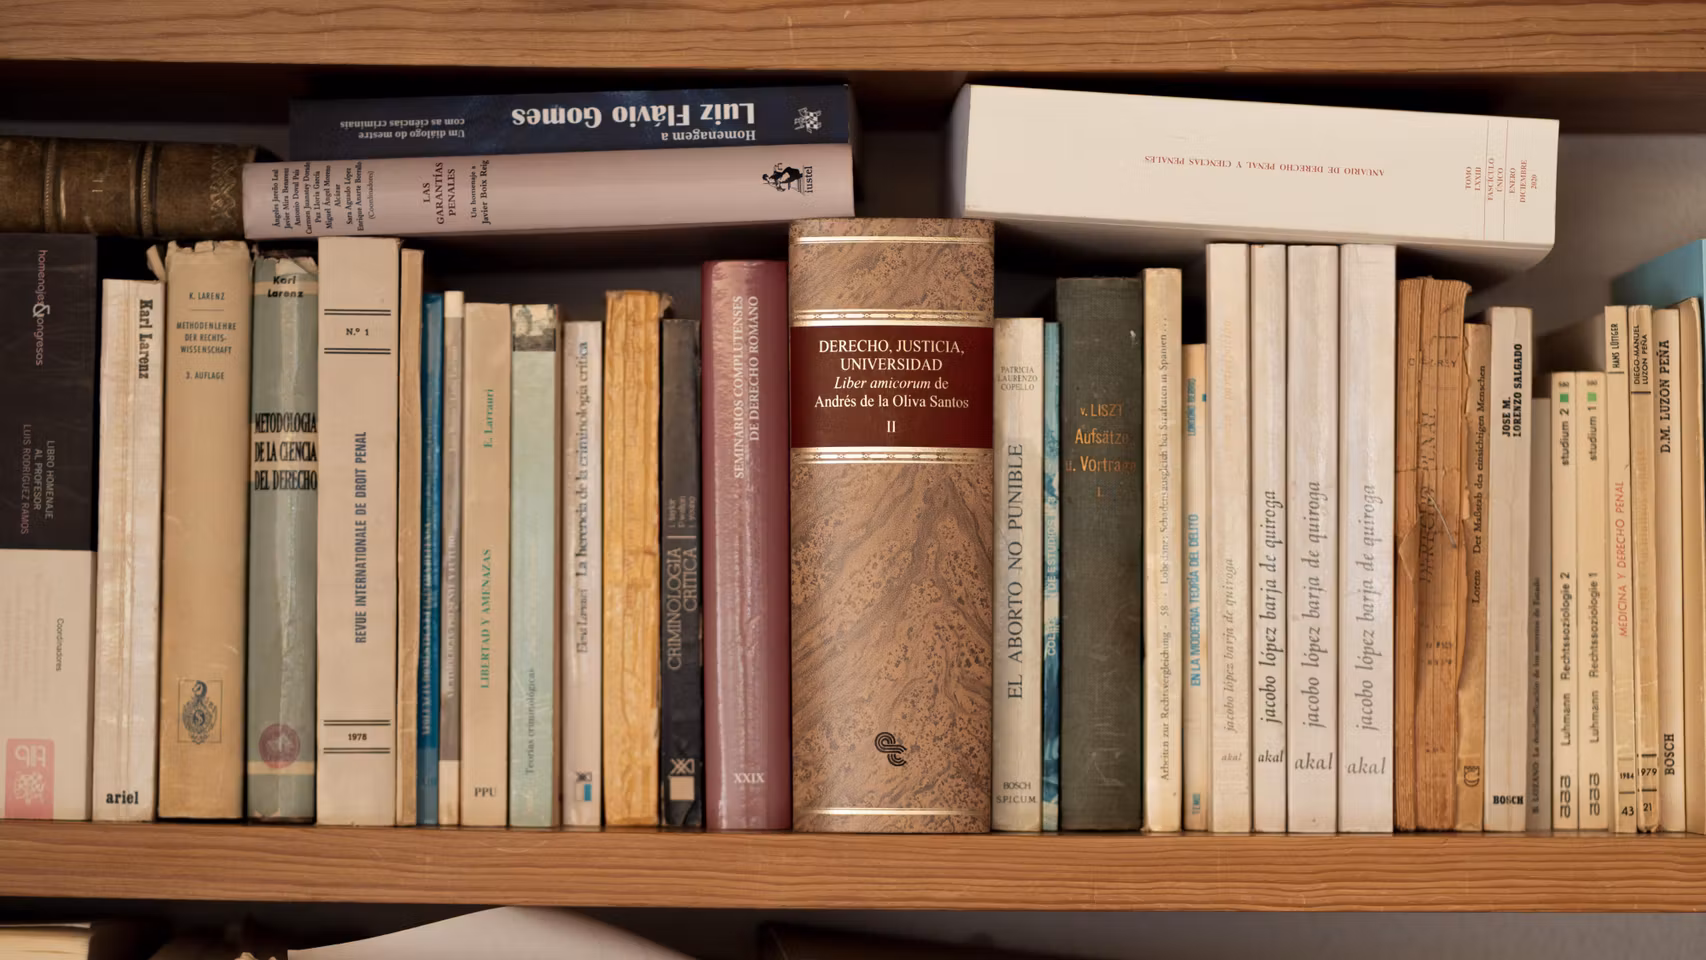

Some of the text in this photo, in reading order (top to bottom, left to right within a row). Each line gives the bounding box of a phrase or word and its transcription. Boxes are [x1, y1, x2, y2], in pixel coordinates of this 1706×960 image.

[340, 119, 429, 130] ciências criminais
[511, 102, 754, 128] Luiz Flávio Gomes
[358, 128, 446, 140] diálogo mestre
[672, 128, 756, 142] Homenagem
[1144, 155, 1384, 177] ANUARIO DERECHO PENAL CIENCIAS PENALES
[470, 172, 478, 204] homenaje
[804, 166, 814, 194] iustel
[1530, 174, 1538, 190] 2020
[422, 182, 430, 202] LAS
[432, 162, 444, 224] GARANTÍAS
[448, 168, 456, 216] PENALES
[480, 160, 491, 224] Javier Boix Reig
[294, 202, 302, 226] Antonio
[326, 208, 334, 228] Miguel
[273, 276, 296, 284] Karl
[198, 292, 225, 300] LARENZ
[268, 288, 304, 298] Larenz
[176, 322, 236, 330] METHODENLEHRE
[365, 328, 370, 336] 1
[138, 299, 153, 379] Karl Larenz
[184, 334, 197, 342] DER
[819, 340, 965, 356] DERECHO, JUSTICIA,
[1640, 334, 1648, 354] PEÑA
[180, 346, 232, 354] WISSENSCHAFT
[748, 296, 760, 420] DERECHO ROMANO
[1611, 352, 1620, 368] HANS
[840, 358, 942, 371] UNIVERSIDAD
[1000, 366, 1034, 374] PATRICIA
[194, 372, 224, 380] AUFLAGE
[834, 376, 930, 389] Liber amicorum
[997, 374, 1038, 382] LAURENZO
[732, 296, 744, 479] SEMINARIOS COMPLUTENSES
[1512, 344, 1522, 437] LORENZO SALGADO
[1656, 340, 1670, 453] D.M. LUZON PEÑA
[483, 389, 494, 434] Larrauri
[814, 394, 969, 408] Andrés Oliva Santos
[254, 412, 318, 434] METODOLOGIA
[886, 420, 896, 433] II
[1502, 412, 1511, 438] JOSE
[1074, 428, 1129, 444] Aufsätze
[1559, 421, 1570, 466] studium
[1587, 416, 1597, 461] studium
[254, 441, 318, 462] DE CIENCIA
[20, 423, 32, 535] LUIS RODRÍGUEZ RAMOS
[45, 440, 56, 520] LIBRO HOMENAJE
[272, 470, 318, 491] DERECHO
[575, 385, 590, 557] herencia criminología
[33, 463, 42, 510] PROFESOR
[1472, 365, 1486, 604] Lorenz einsichtigen Menschen
[355, 432, 368, 643] REVUE INTERNATIONALE DROIT PENAL
[1047, 519, 1057, 574] ESTUDIOS
[1008, 444, 1023, 664] ABORTO PUNIBLE
[1159, 334, 1172, 780] Arbeiten Rechtsvergleichung Spanien
[1614, 481, 1628, 637] MEDICINA DERECHO PENAL
[1187, 514, 1200, 656] MODERNA TEORÍA DELITO
[667, 548, 682, 670] CRIMINOLOGIA
[1259, 490, 1284, 724] jacobo lópez barja quiroga
[1300, 481, 1328, 728] jacobo lópez barja quiroga
[1354, 484, 1383, 732] jacobo lópez barja quiroga
[480, 549, 491, 689] LIBERTAD AMENAZAS
[56, 618, 64, 672] Coordinadores
[1222, 558, 1238, 734] jacobo quiroga
[1560, 584, 1572, 746] Luhmann Rechtssoziologie
[1588, 581, 1600, 743] Luhmann Rechtssoziologie
[348, 733, 368, 741] 1978
[1221, 752, 1242, 761] akal
[1258, 749, 1284, 763] akal
[1294, 752, 1334, 770] akal
[1346, 756, 1386, 774] akal
[1663, 734, 1675, 776] BOSCH
[734, 772, 766, 784] XXIX
[1003, 782, 1032, 790] BOSCH
[1620, 772, 1634, 780] 1984
[106, 790, 139, 804] ariel
[474, 786, 497, 798] PPU
[1493, 796, 1524, 805] BOSCH
[1621, 806, 1634, 816] 43
[1642, 802, 1652, 812] 21
